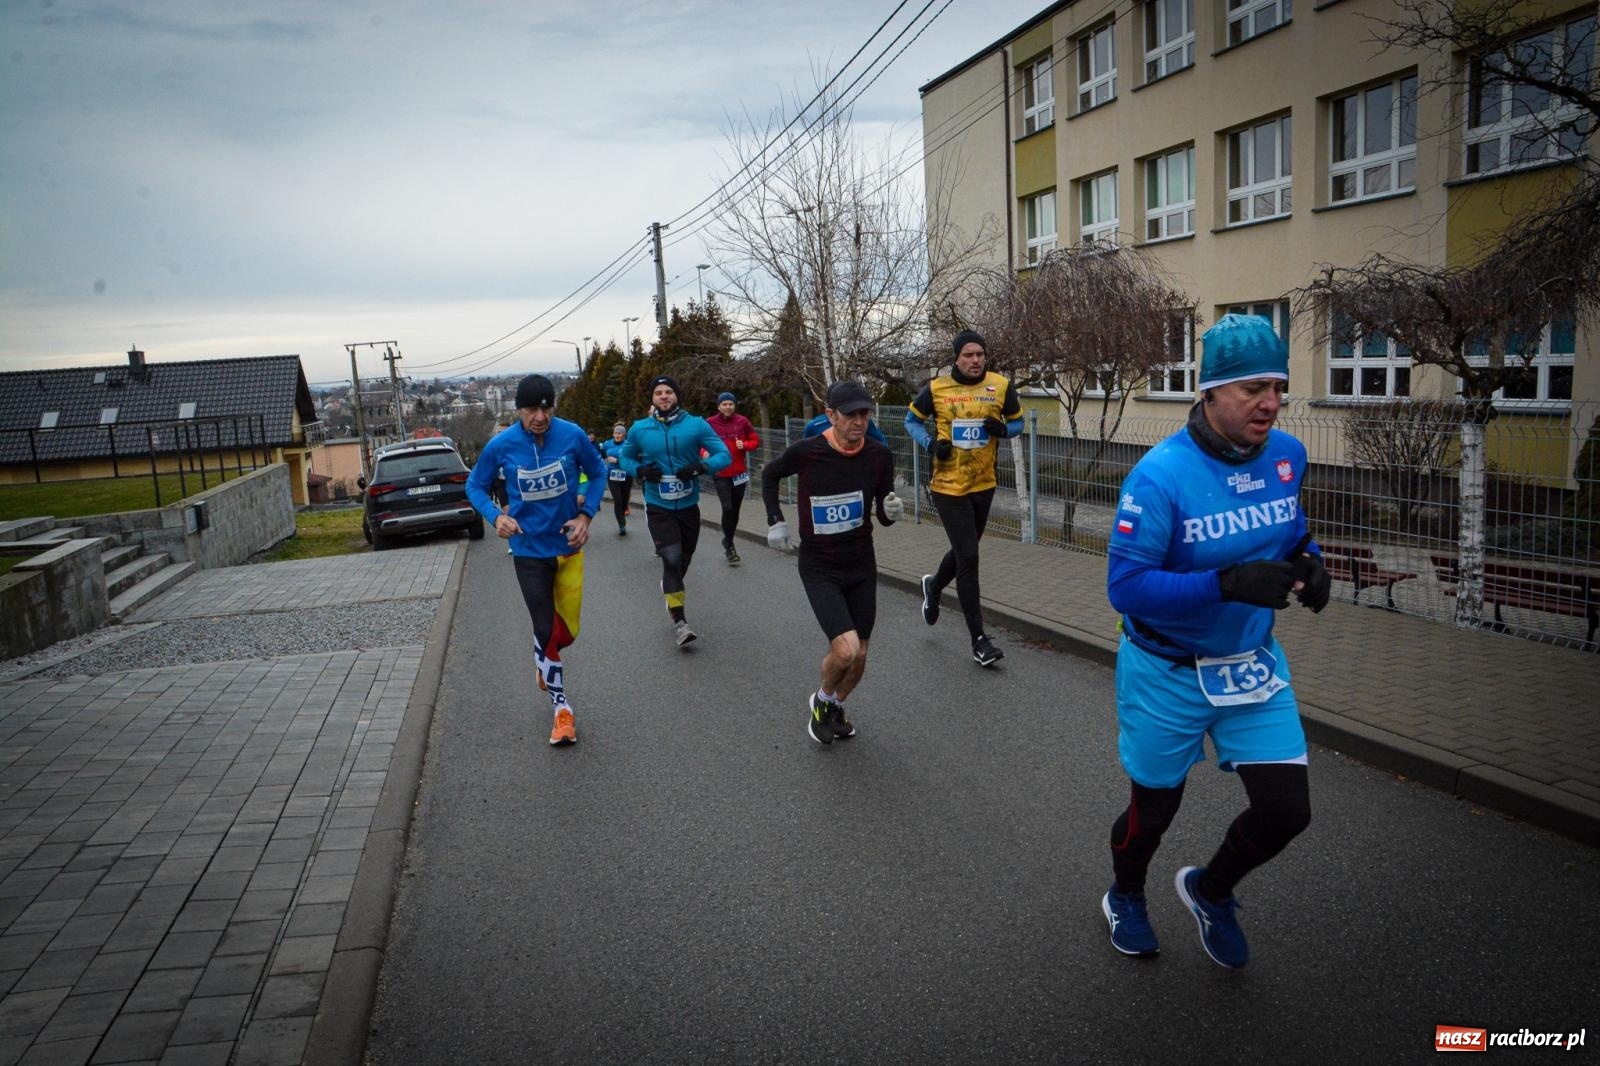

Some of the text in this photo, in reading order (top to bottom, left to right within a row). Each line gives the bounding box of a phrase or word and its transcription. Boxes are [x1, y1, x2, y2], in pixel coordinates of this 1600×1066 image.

[962, 427, 980, 440] 40
[525, 473, 559, 492] 216
[669, 481, 684, 493] 50
[826, 504, 850, 522] 80
[1217, 654, 1270, 694] 135
